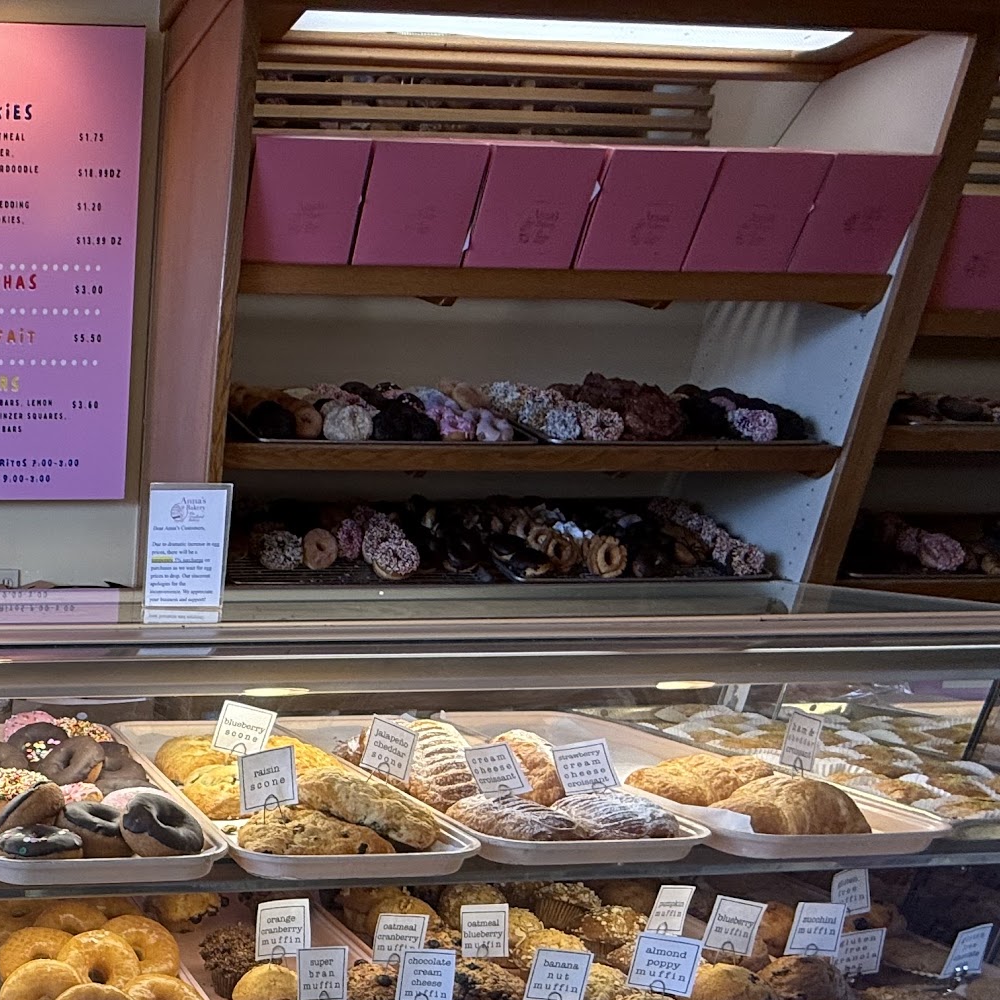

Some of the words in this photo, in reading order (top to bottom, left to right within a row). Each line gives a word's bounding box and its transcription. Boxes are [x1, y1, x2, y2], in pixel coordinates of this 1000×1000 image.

[79, 132, 104, 142] $1.75
[75, 285, 103, 295] $3.00
[73, 334, 102, 344] $5.50
[224, 718, 266, 734] blueberry
[225, 729, 258, 743] scone
[374, 728, 409, 748] jalapeño
[373, 740, 406, 758] cheddar
[371, 751, 402, 769] scone
[472, 754, 506, 765] cream
[558, 750, 600, 761] strawberry
[474, 764, 512, 775] cheese
[563, 759, 601, 770] cream
[254, 765, 280, 778] raisin
[564, 768, 606, 779] cheese
[250, 776, 286, 791] scone
[478, 773, 516, 784] croissant
[567, 776, 610, 788] croissant
[266, 915, 296, 924] orange
[654, 910, 682, 918] muffin
[467, 920, 499, 928] oatmeal
[717, 913, 755, 928] blueberry
[802, 916, 837, 924] zucchini
[261, 926, 303, 935] cranberry
[383, 923, 416, 932] oatmeal
[714, 926, 748, 939] muffin
[798, 927, 836, 936] muffin
[377, 933, 419, 944] cranberry
[464, 930, 503, 940] blueberry
[261, 937, 301, 947] muffin
[645, 946, 687, 959] almond
[309, 958, 333, 967] super
[408, 958, 451, 967] chocolate
[544, 959, 579, 970] banana
[646, 958, 682, 970] poppy
[308, 969, 335, 978] bran
[413, 969, 442, 977] cream
[547, 972, 570, 981] nut
[635, 967, 686, 982] muffin
[303, 981, 340, 991] muffin
[411, 979, 442, 988] cheese
[533, 982, 578, 994] muffin
[404, 990, 447, 1000] muffin
